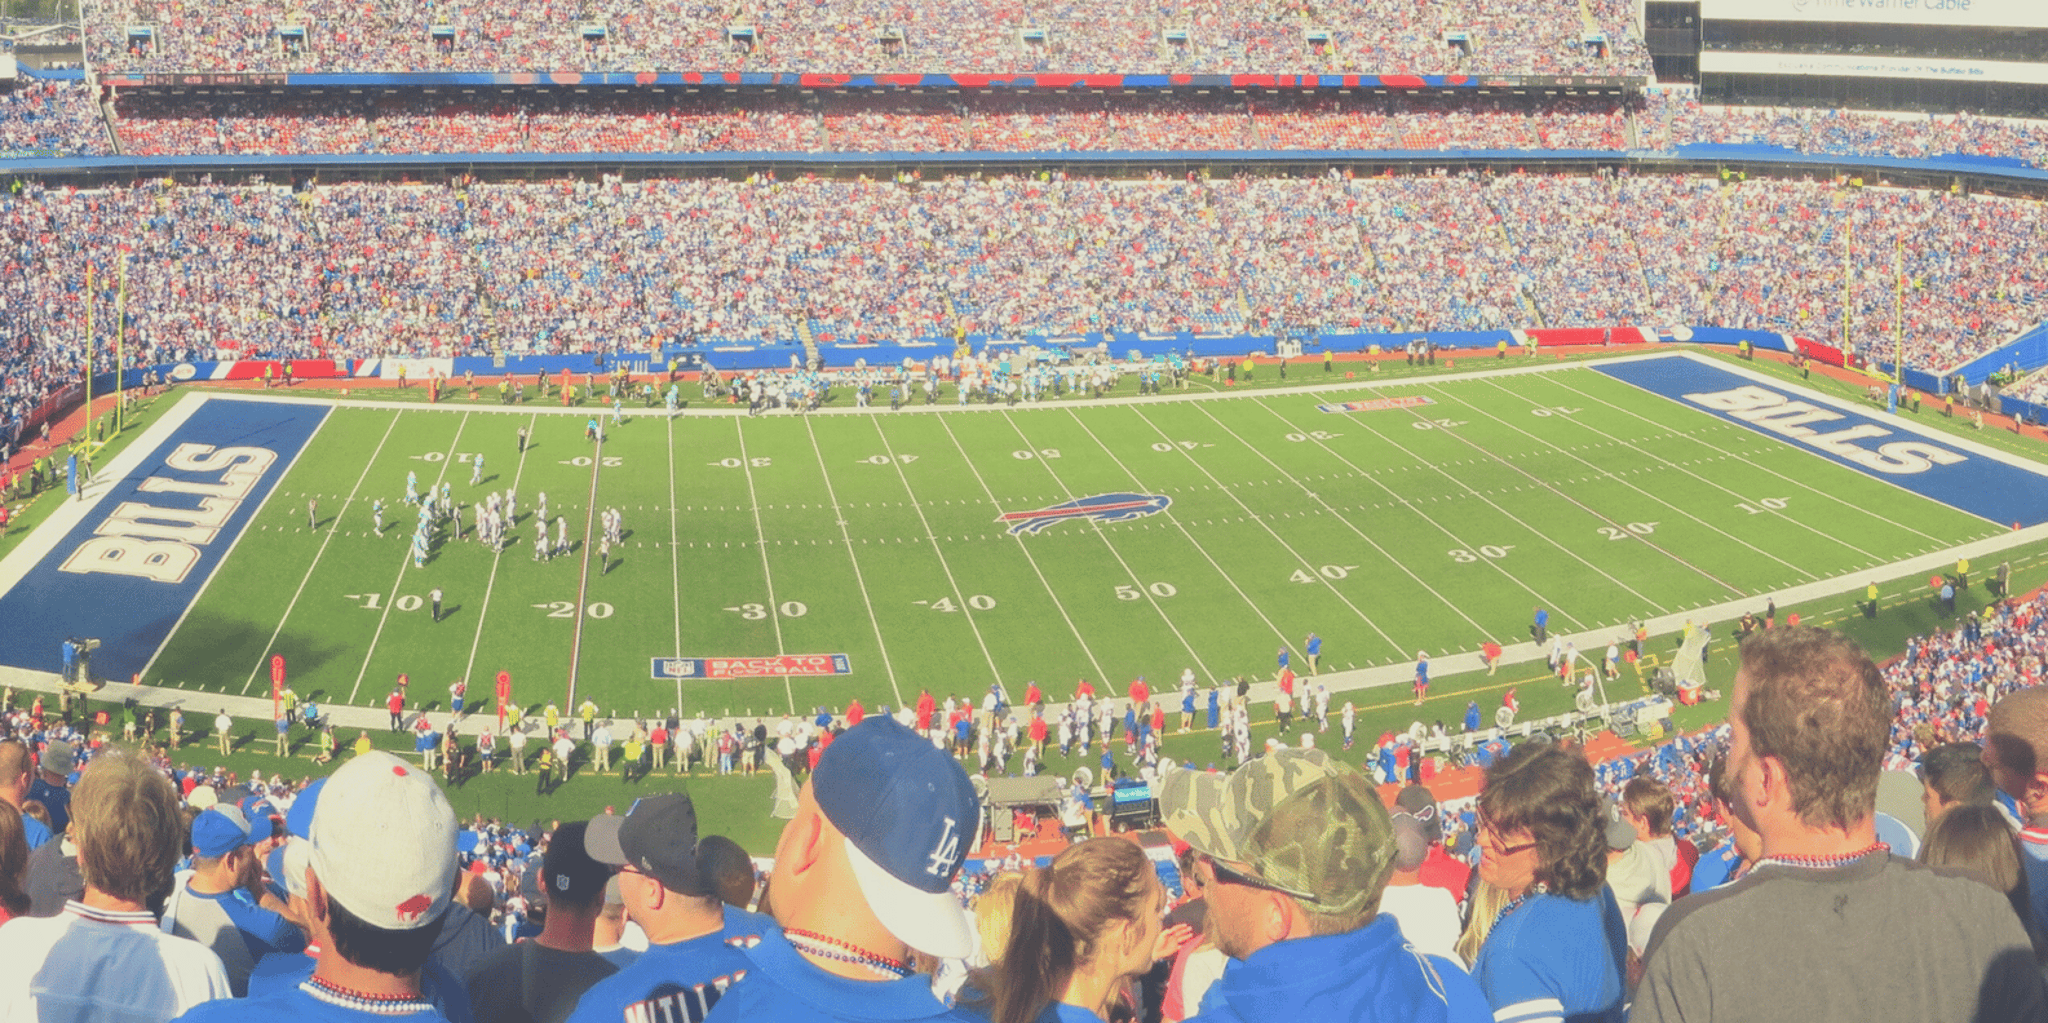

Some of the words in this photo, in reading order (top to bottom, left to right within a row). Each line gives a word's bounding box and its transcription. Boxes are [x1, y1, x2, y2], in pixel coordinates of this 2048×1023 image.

[1680, 384, 1969, 474] BILLS
[57, 442, 279, 584] BILLS
[1114, 582, 1177, 601] 50
[546, 601, 615, 619] 20
[741, 601, 808, 620] 30
[931, 594, 996, 612] 40
[711, 658, 782, 670] BACK
[790, 656, 826, 666] TO
[712, 665, 829, 677] FOOTBALL
[927, 817, 960, 877] LA
